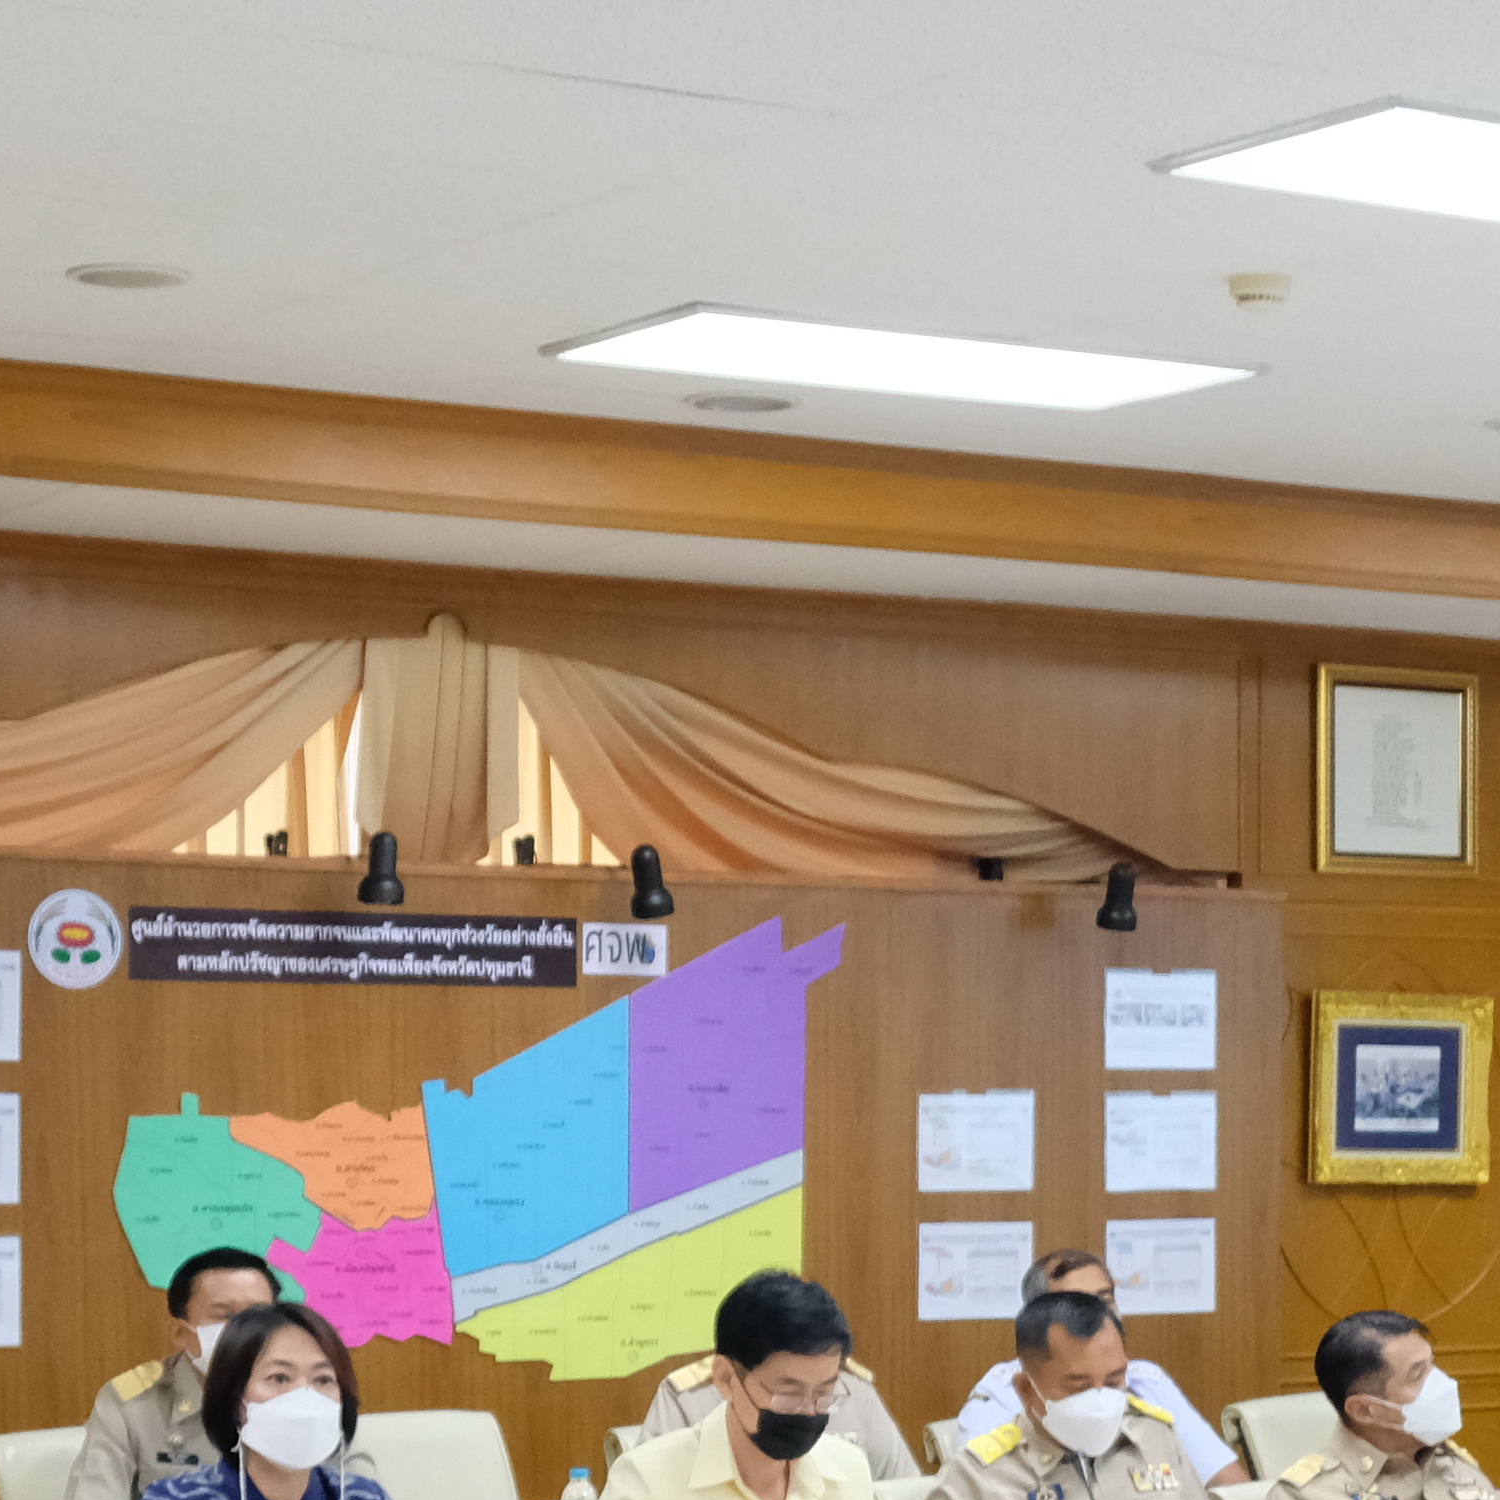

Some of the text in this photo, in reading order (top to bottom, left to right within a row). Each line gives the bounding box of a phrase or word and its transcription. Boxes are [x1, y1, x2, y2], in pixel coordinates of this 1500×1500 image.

[177, 949, 534, 981] ตามหลักปรัชญาของเศรษฐกิจพอเพียงจังหวัดปทุมธานี
